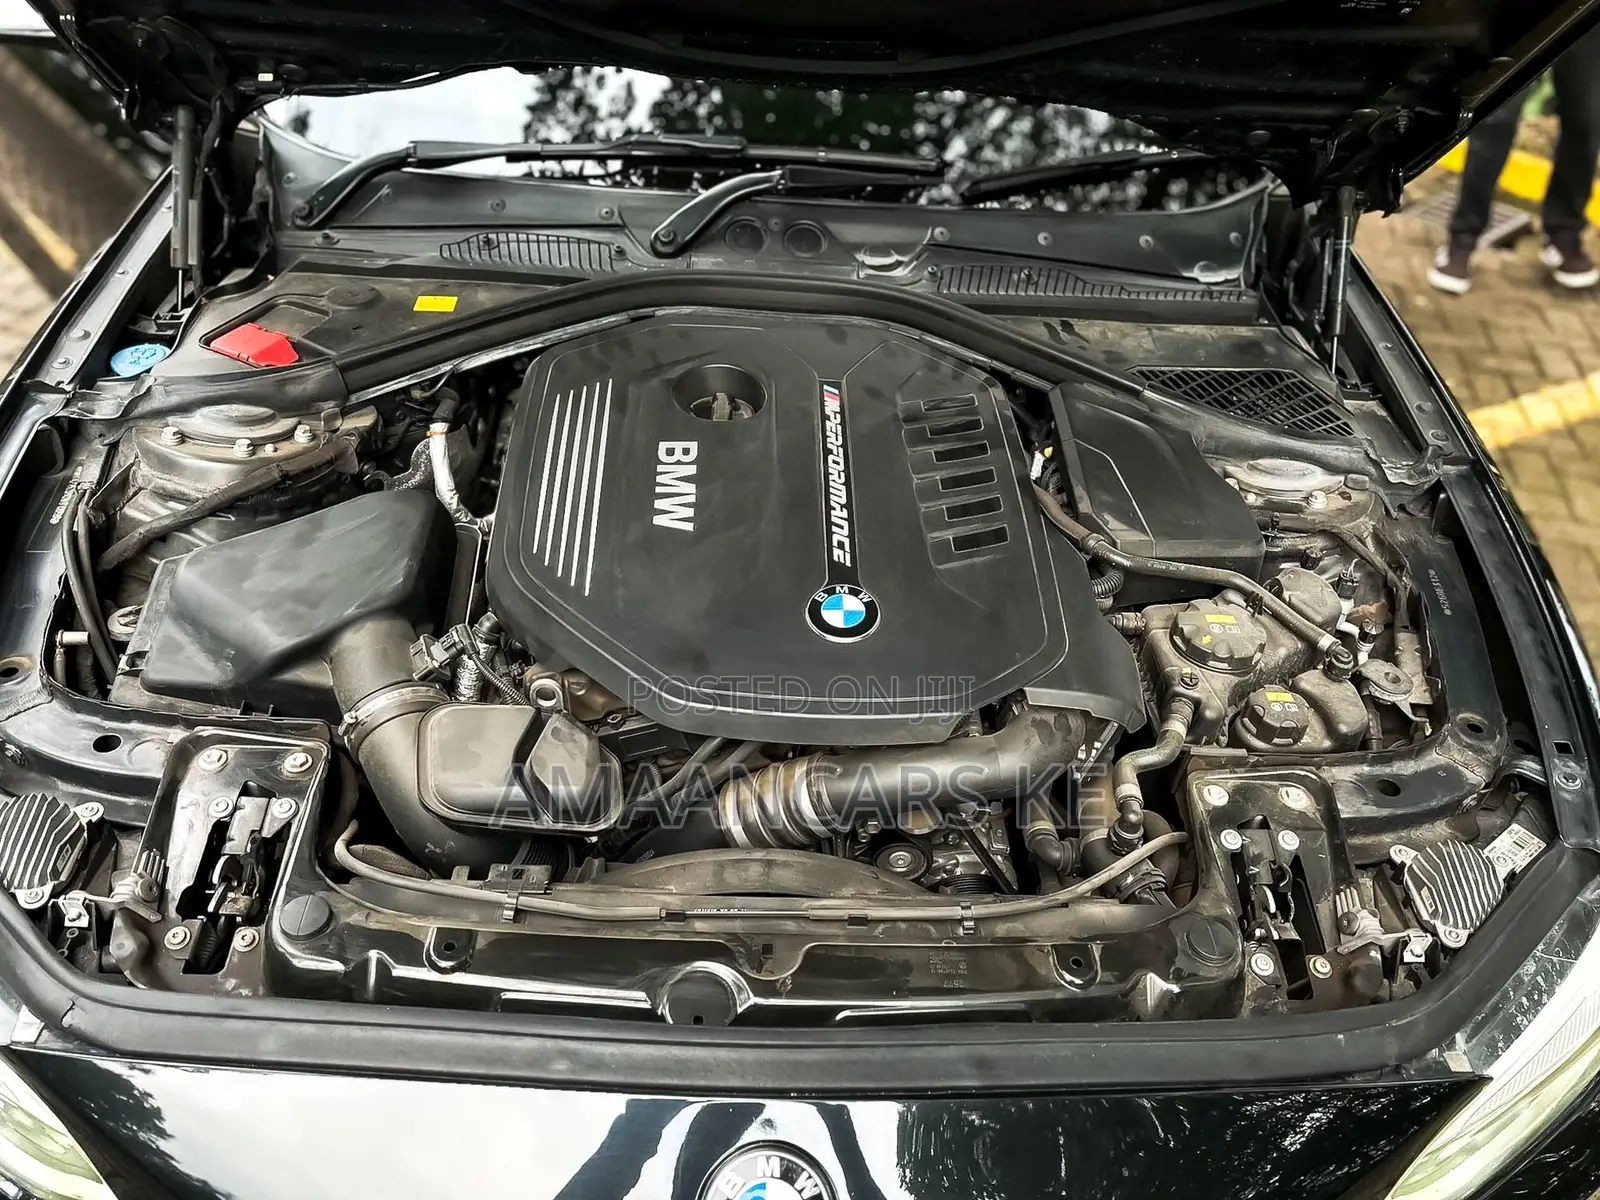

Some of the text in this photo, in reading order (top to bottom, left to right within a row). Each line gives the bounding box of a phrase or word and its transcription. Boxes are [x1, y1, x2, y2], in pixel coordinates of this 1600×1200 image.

[652, 441, 698, 531] BMW
[814, 586, 872, 602] BMW
[714, 1154, 822, 1200] BMW
